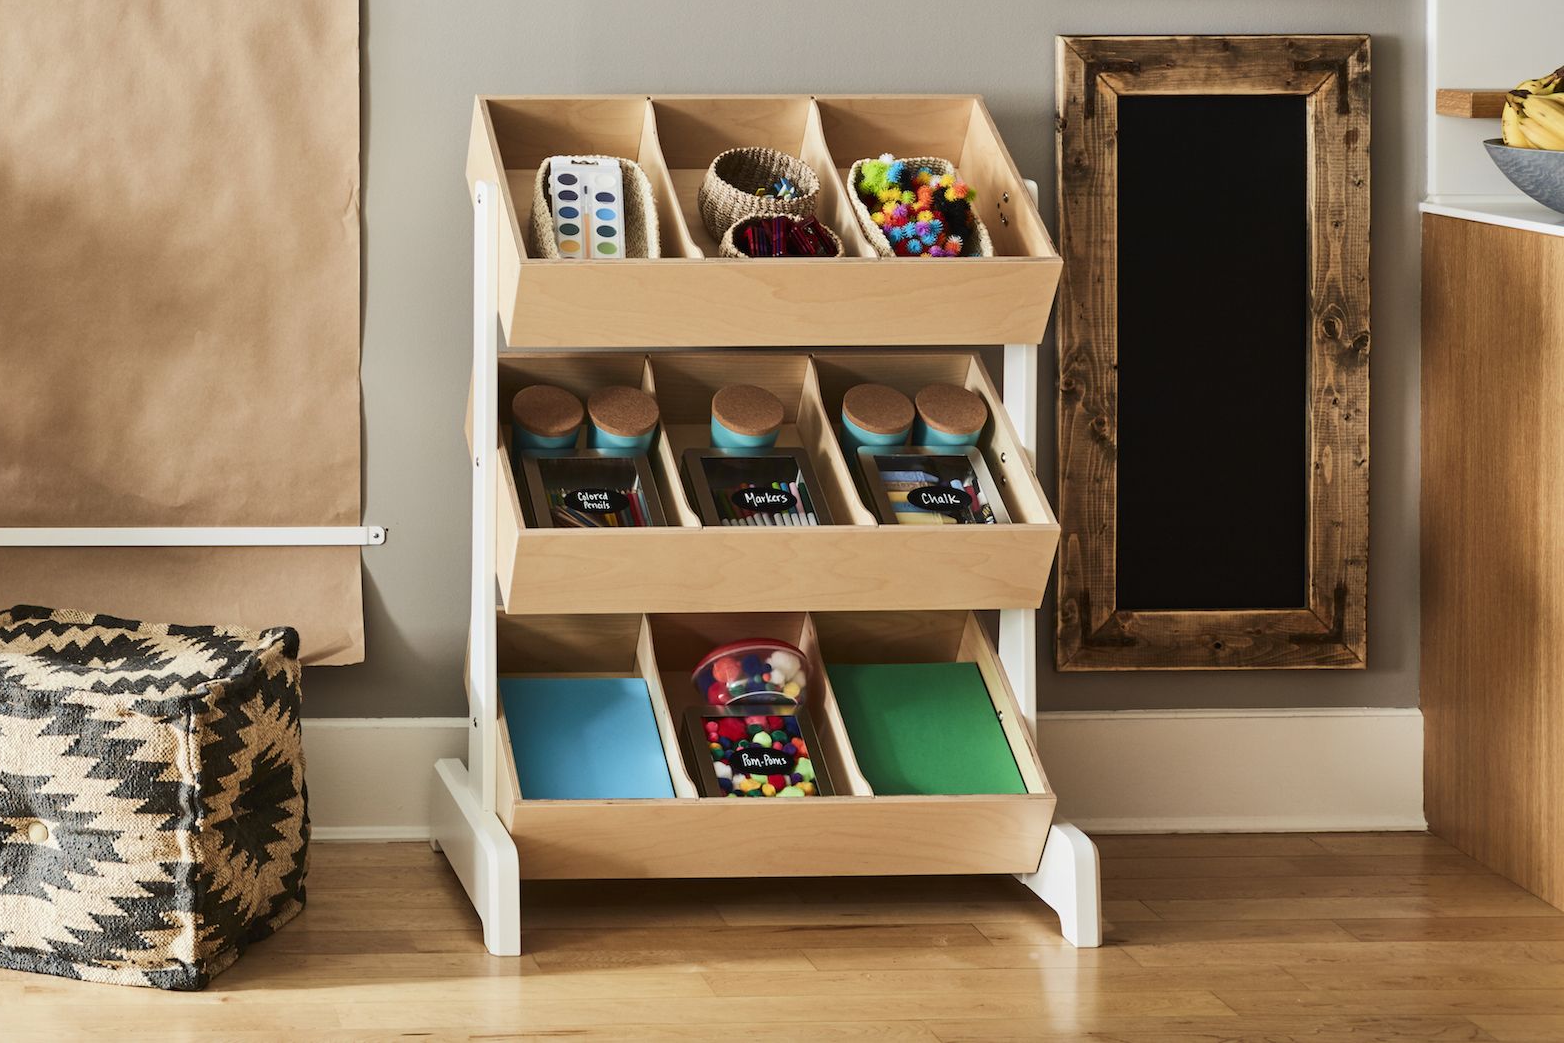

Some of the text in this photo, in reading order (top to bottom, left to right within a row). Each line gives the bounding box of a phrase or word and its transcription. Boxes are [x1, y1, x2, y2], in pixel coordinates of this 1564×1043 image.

[577, 491, 609, 502] Colored
[744, 492, 788, 507] Markers
[921, 492, 961, 505] Chalk
[583, 500, 611, 510] Pencils
[741, 753, 787, 767] Pom-Poms
